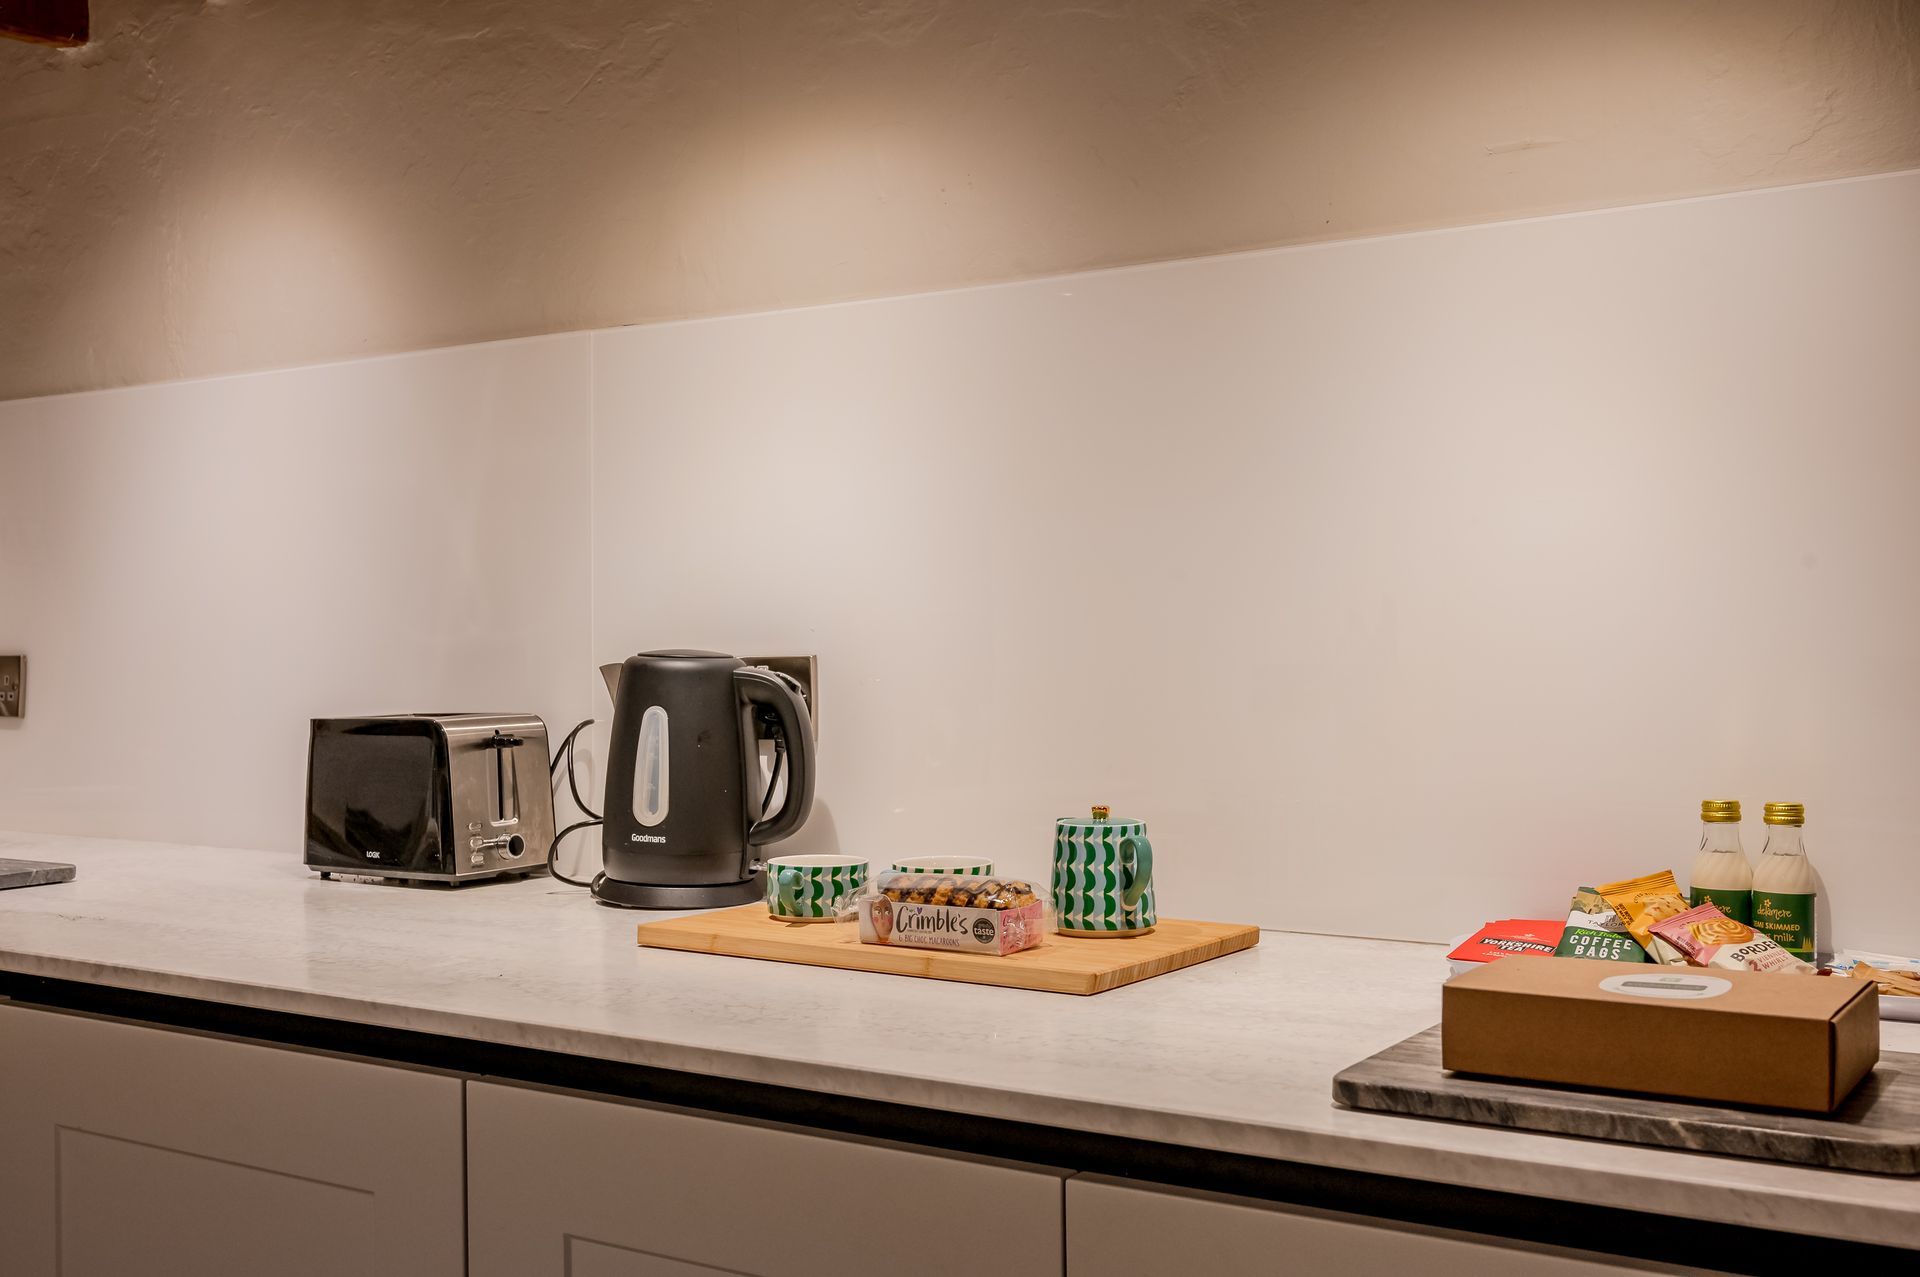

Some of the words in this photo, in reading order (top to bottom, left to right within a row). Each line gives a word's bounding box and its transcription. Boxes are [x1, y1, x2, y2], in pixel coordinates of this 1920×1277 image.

[631, 833, 667, 844] Goodmans
[1757, 904, 1792, 920] delamere
[896, 905, 969, 935] Crimble's
[1754, 921, 1764, 929] EMI
[1765, 922, 1800, 932] SKIMMED
[974, 927, 995, 936] taste
[1773, 932, 1795, 943] milk
[904, 934, 914, 943] BIG
[928, 936, 960, 947] MACAROONS
[1482, 938, 1554, 953] YORKSHIRE
[1569, 935, 1633, 950] COFFEE
[1575, 945, 1621, 960] BAGS
[1748, 959, 1762, 972] 2
